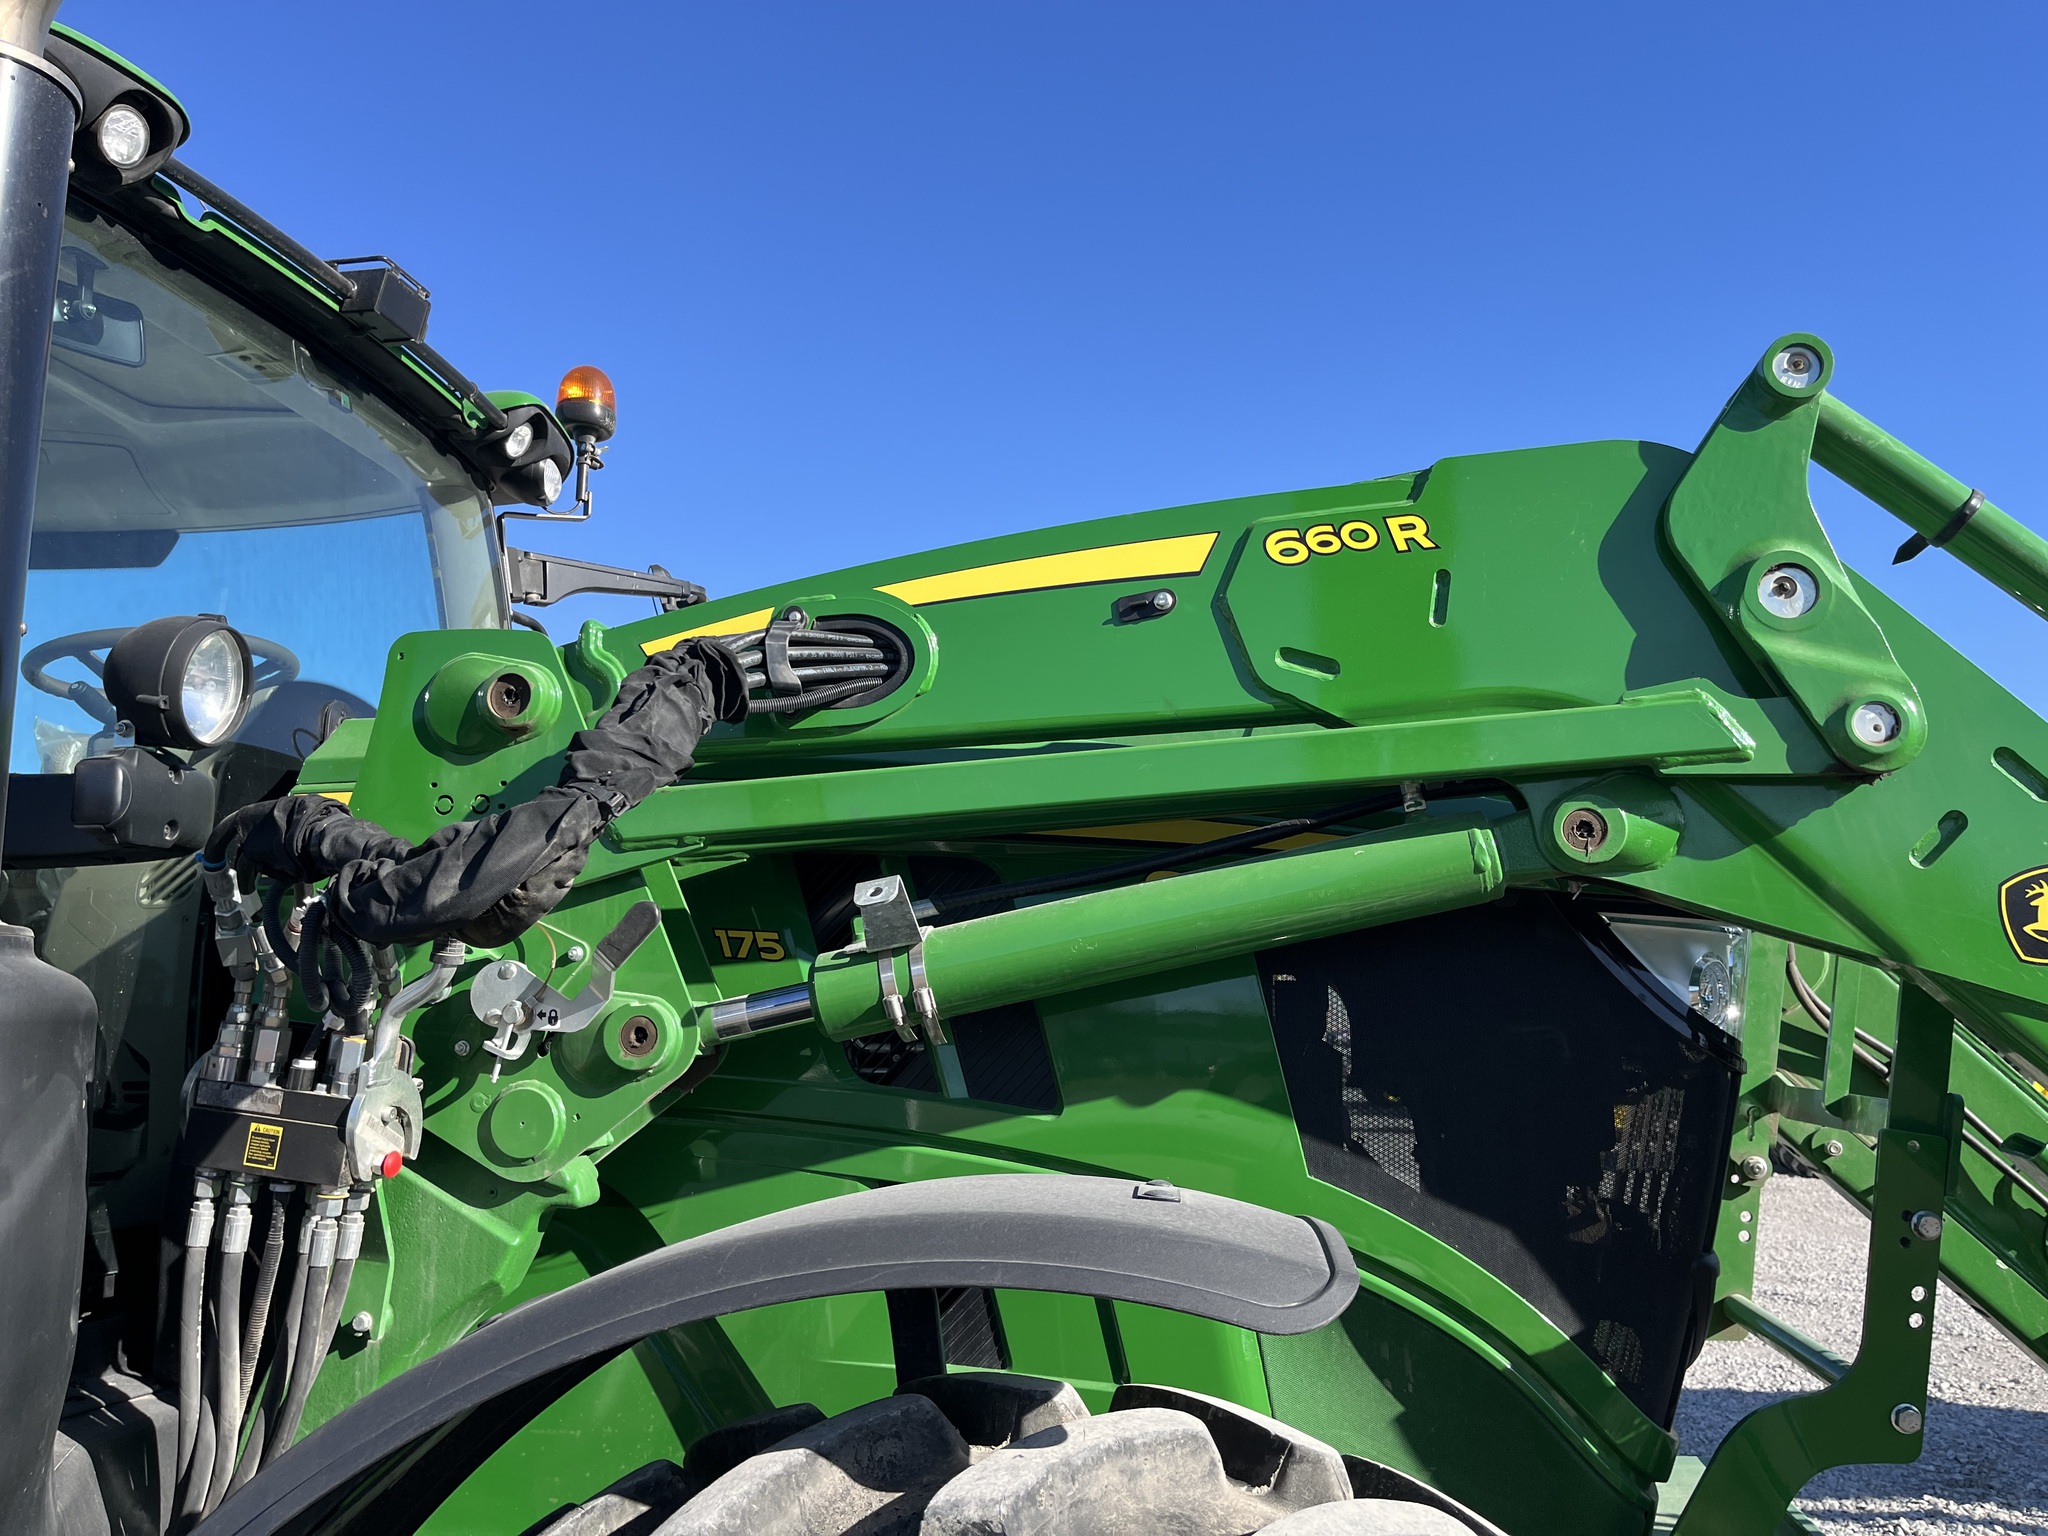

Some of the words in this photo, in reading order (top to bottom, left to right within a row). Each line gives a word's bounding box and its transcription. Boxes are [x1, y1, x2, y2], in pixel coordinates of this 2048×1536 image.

[1262, 519, 1380, 566] 660
[1382, 513, 1441, 554] R
[713, 928, 786, 962] 175
